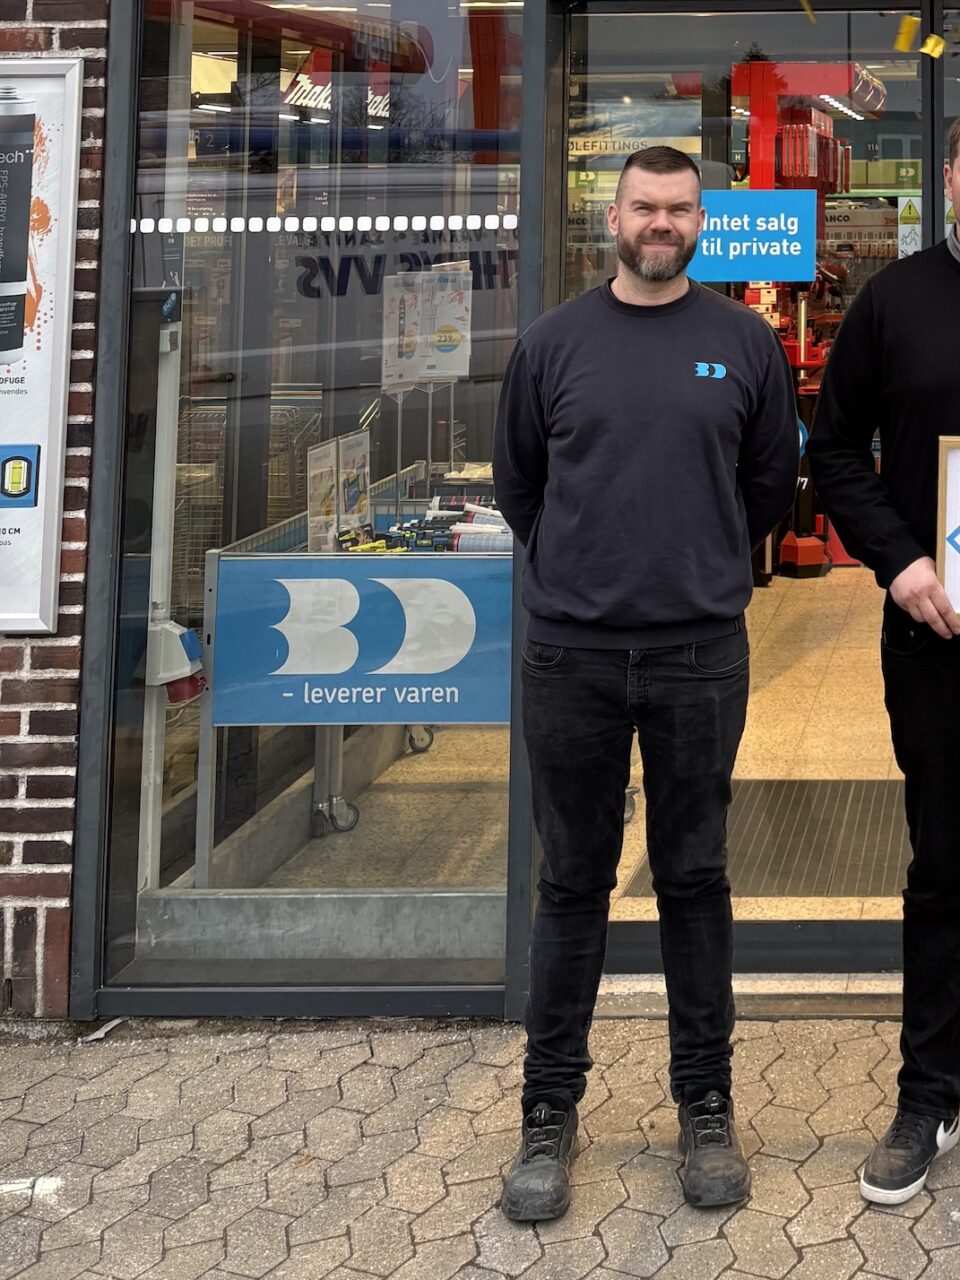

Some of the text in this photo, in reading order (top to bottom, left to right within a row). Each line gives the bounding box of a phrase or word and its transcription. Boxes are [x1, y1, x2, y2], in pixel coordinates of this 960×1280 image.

[702, 213, 799, 235] Intet salg
[702, 237, 802, 260] til private
[694, 361, 727, 380] BD
[267, 577, 477, 676] BD
[303, 682, 387, 704] leverer
[393, 686, 460, 704] varen
